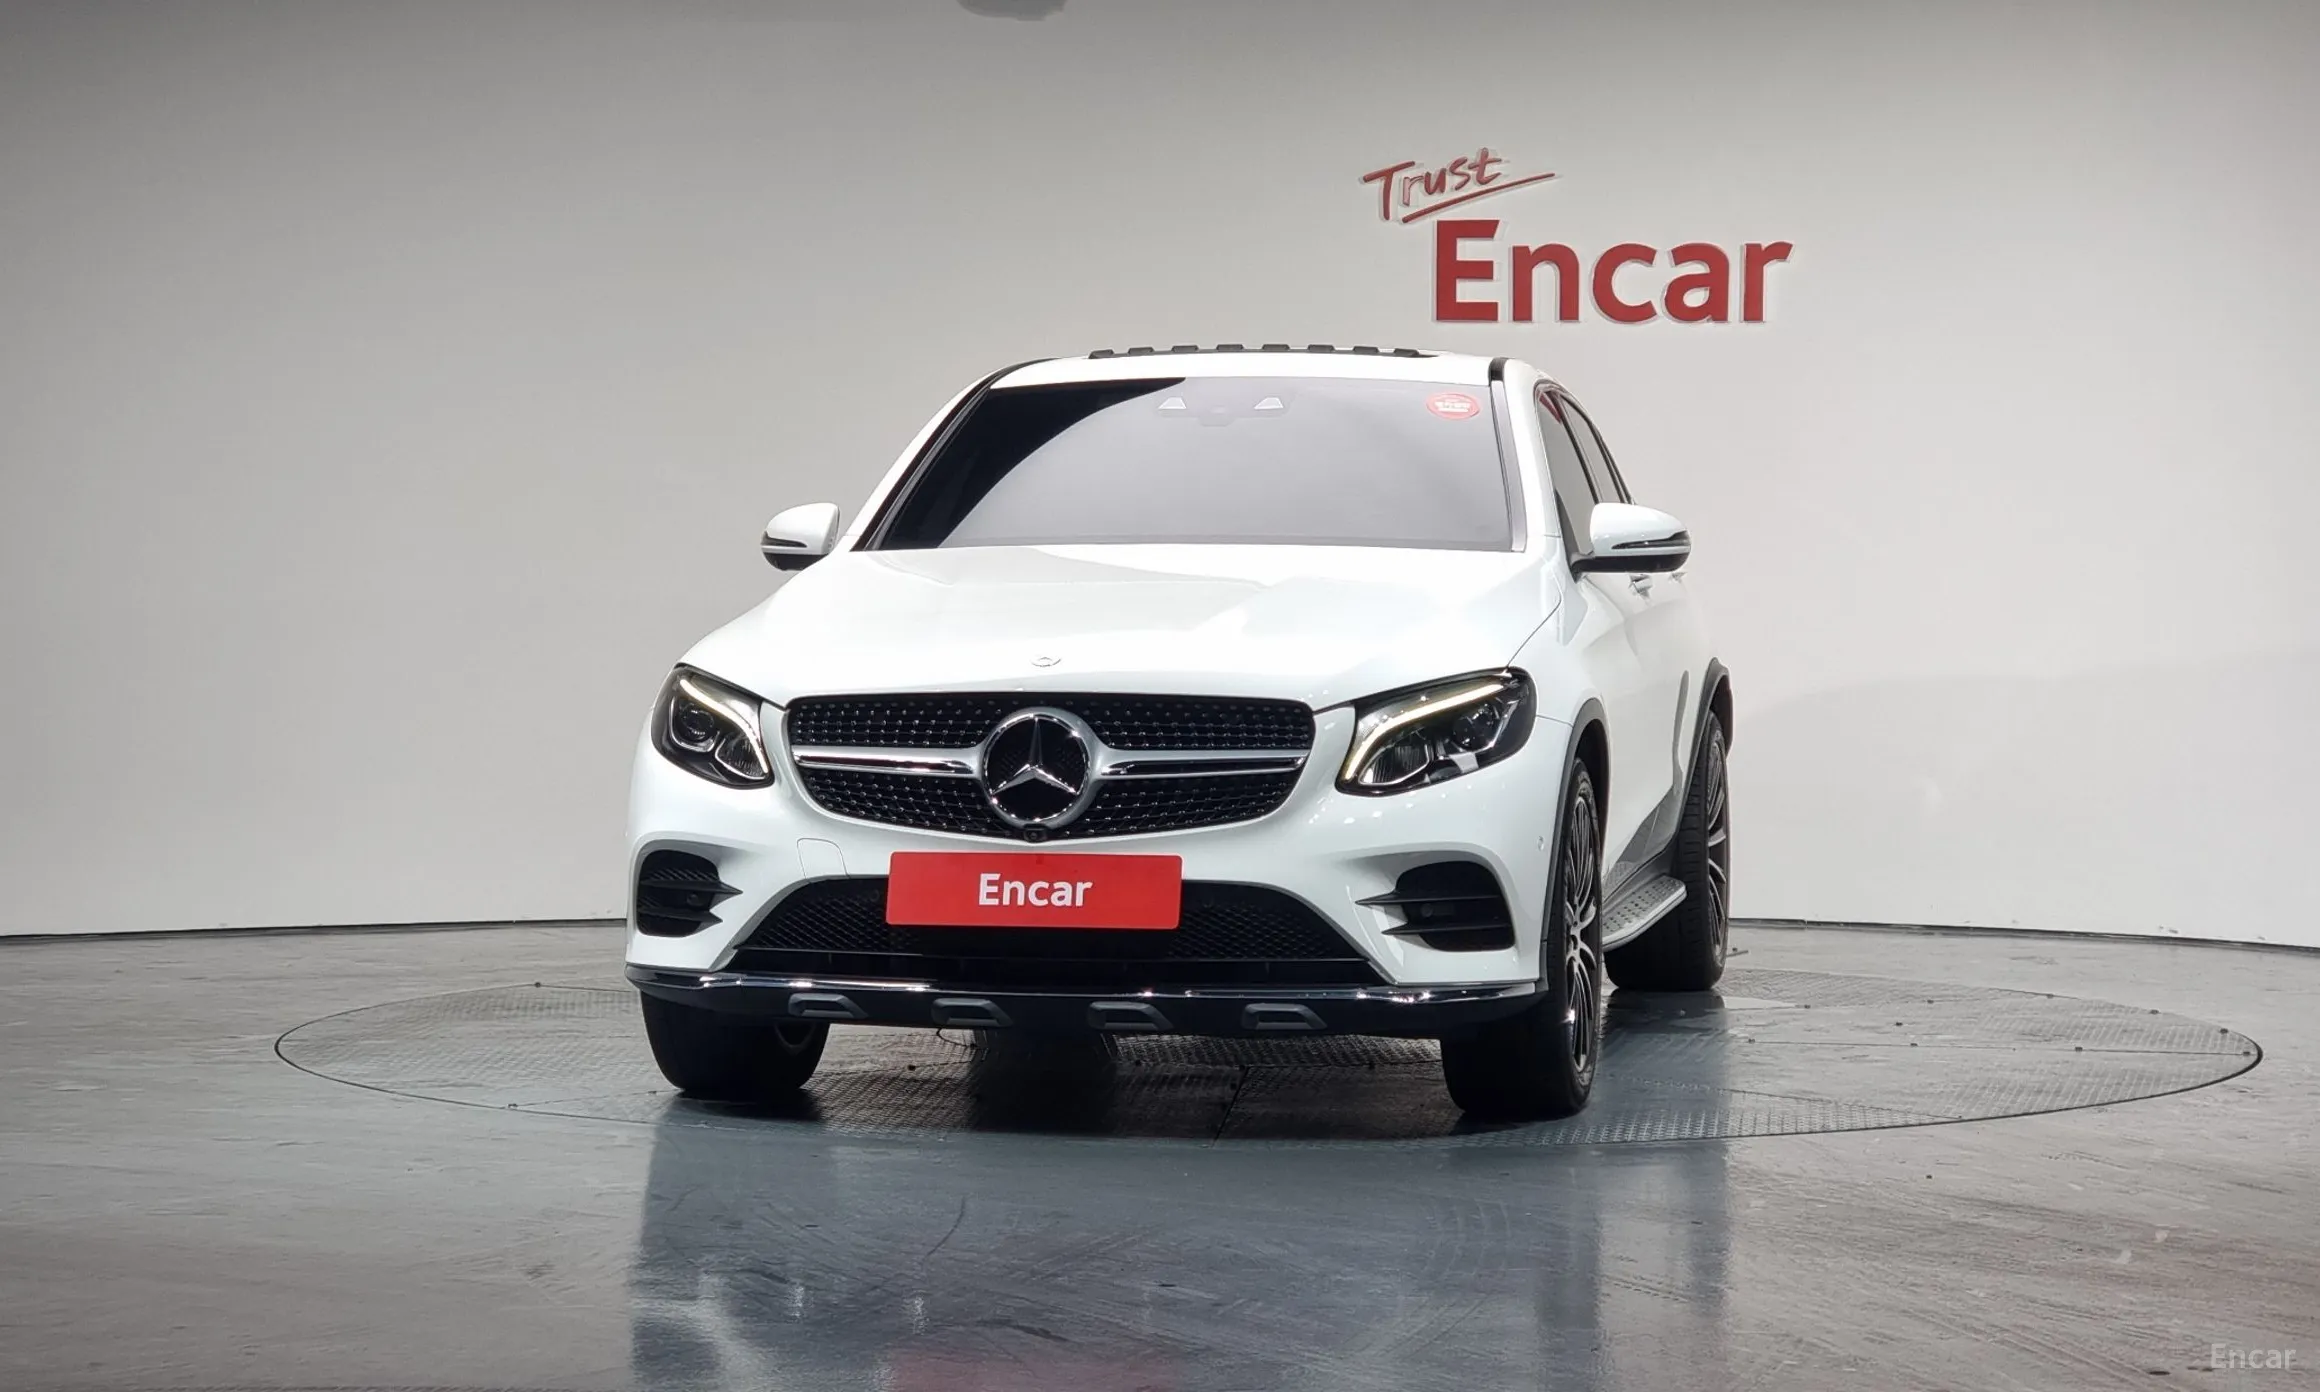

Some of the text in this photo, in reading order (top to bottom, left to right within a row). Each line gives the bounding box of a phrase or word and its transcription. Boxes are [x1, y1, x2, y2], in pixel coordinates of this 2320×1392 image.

[1362, 148, 1506, 221] Trust
[1435, 219, 1794, 323] Encar
[978, 873, 1093, 907] Encar
